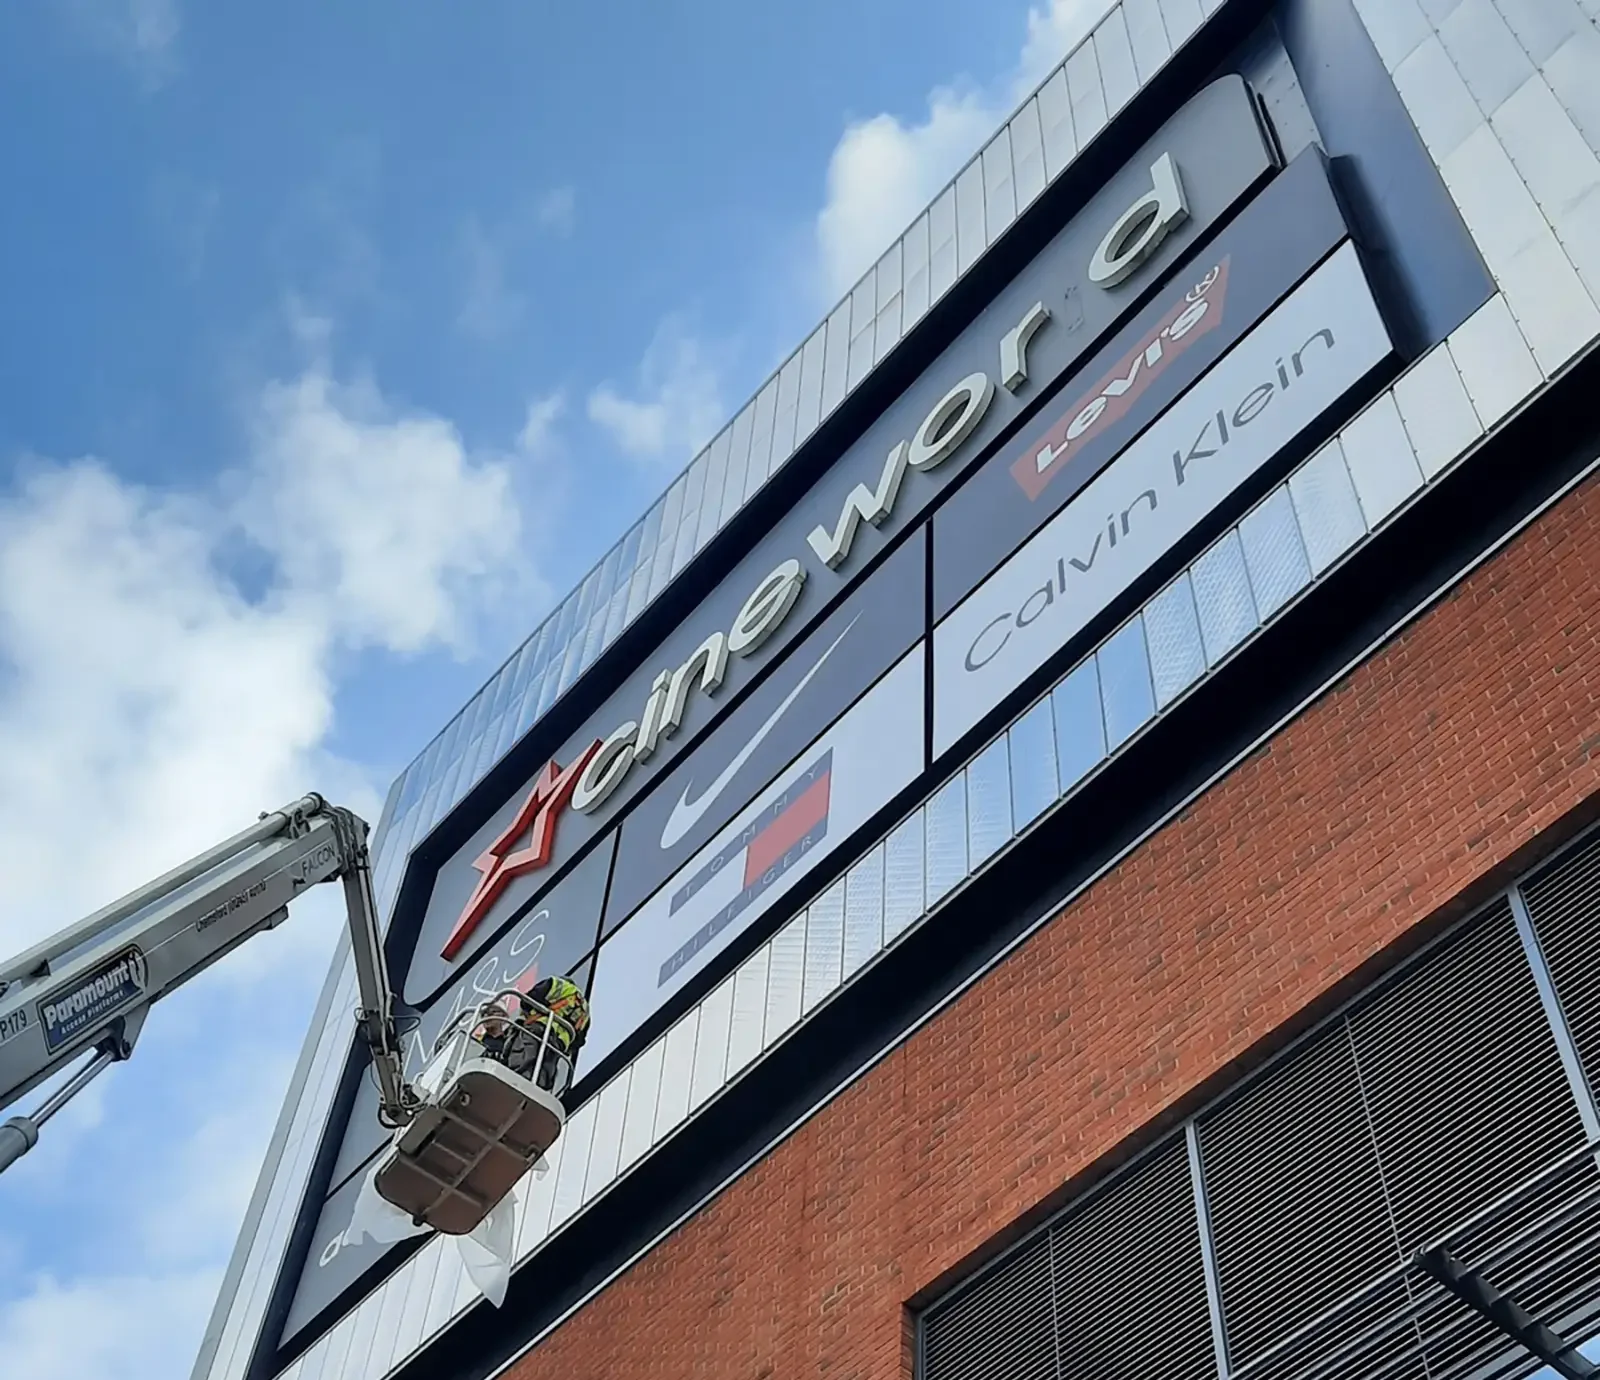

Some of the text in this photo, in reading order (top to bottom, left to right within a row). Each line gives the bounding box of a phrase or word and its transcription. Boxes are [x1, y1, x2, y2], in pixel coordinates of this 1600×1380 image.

[964, 327, 1336, 672] Calvin Klein
[301, 841, 336, 878] FALCON
[683, 768, 819, 899] TOMMY
[668, 835, 815, 971] HILFIGER
[42, 959, 130, 1031] Paramount
